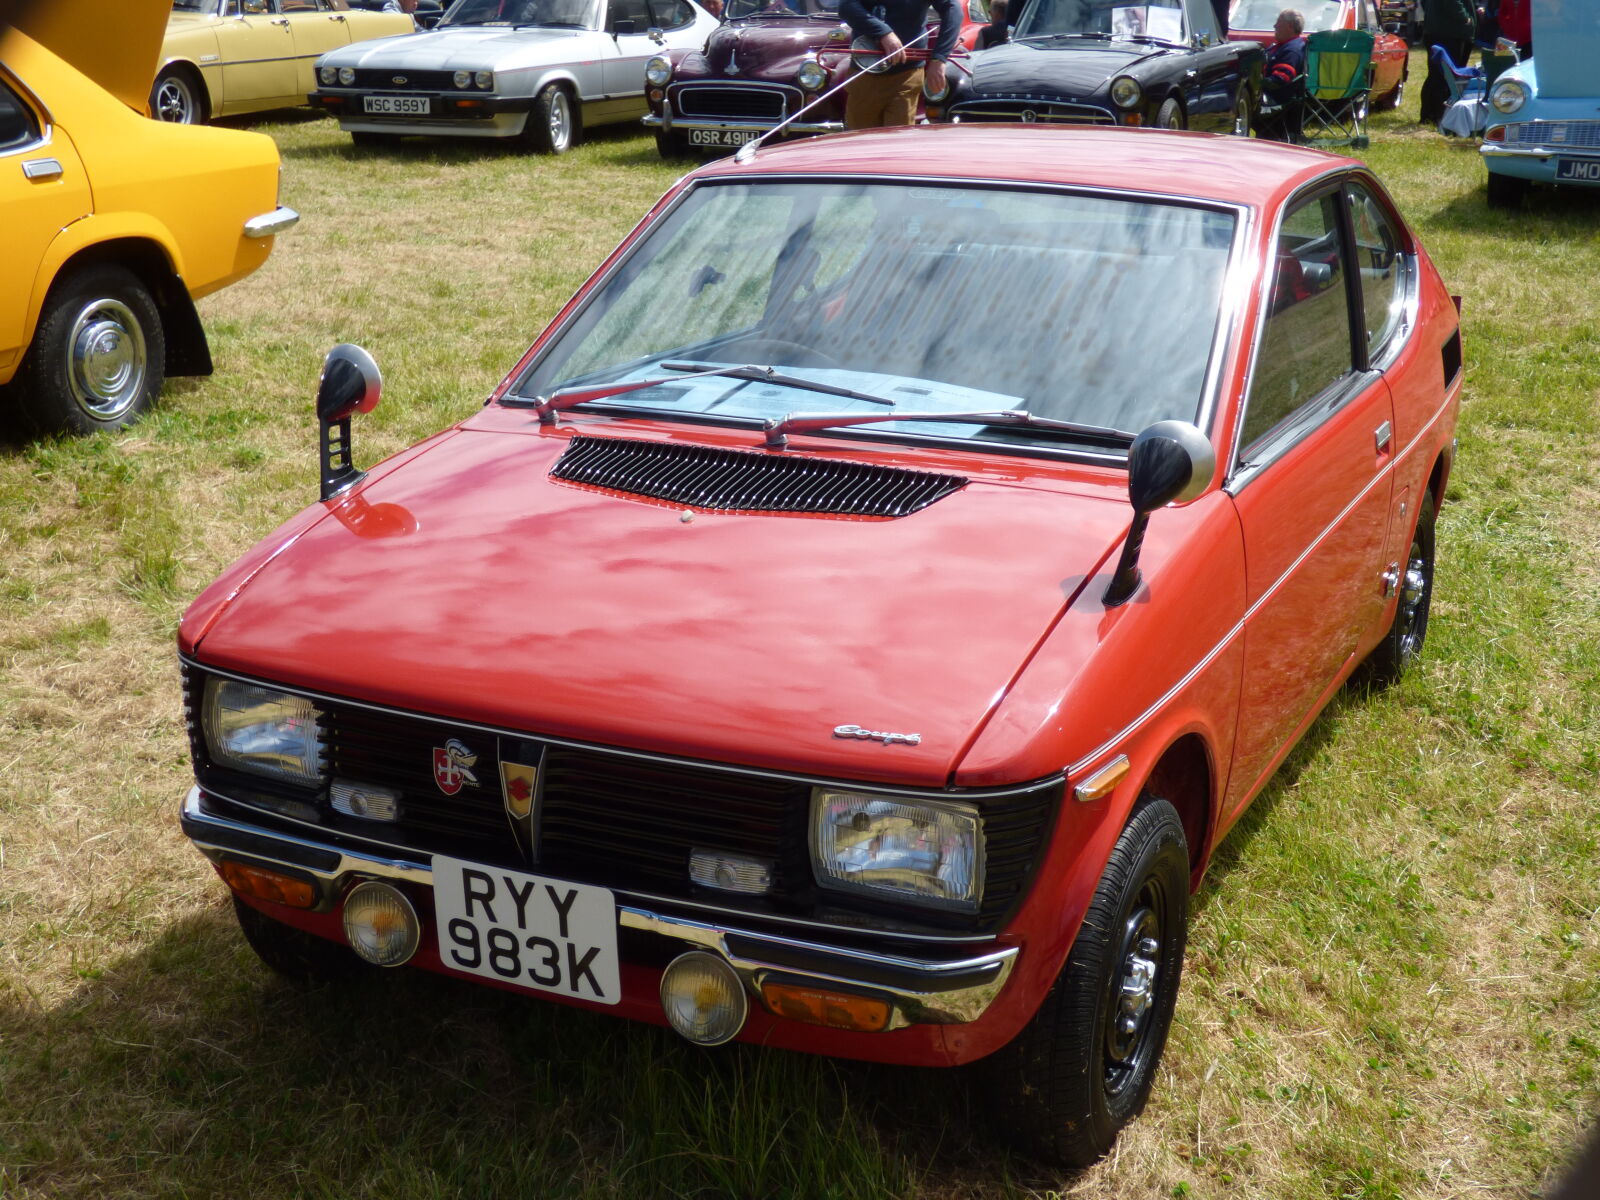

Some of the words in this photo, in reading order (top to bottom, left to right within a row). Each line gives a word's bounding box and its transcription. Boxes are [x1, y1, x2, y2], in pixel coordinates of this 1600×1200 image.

[365, 98, 391, 112] WSC
[394, 99, 427, 112] 959Y
[693, 131, 720, 144] OSR
[1562, 162, 1600, 178] JMO
[462, 867, 579, 938] RYY
[448, 918, 605, 997] 983K
